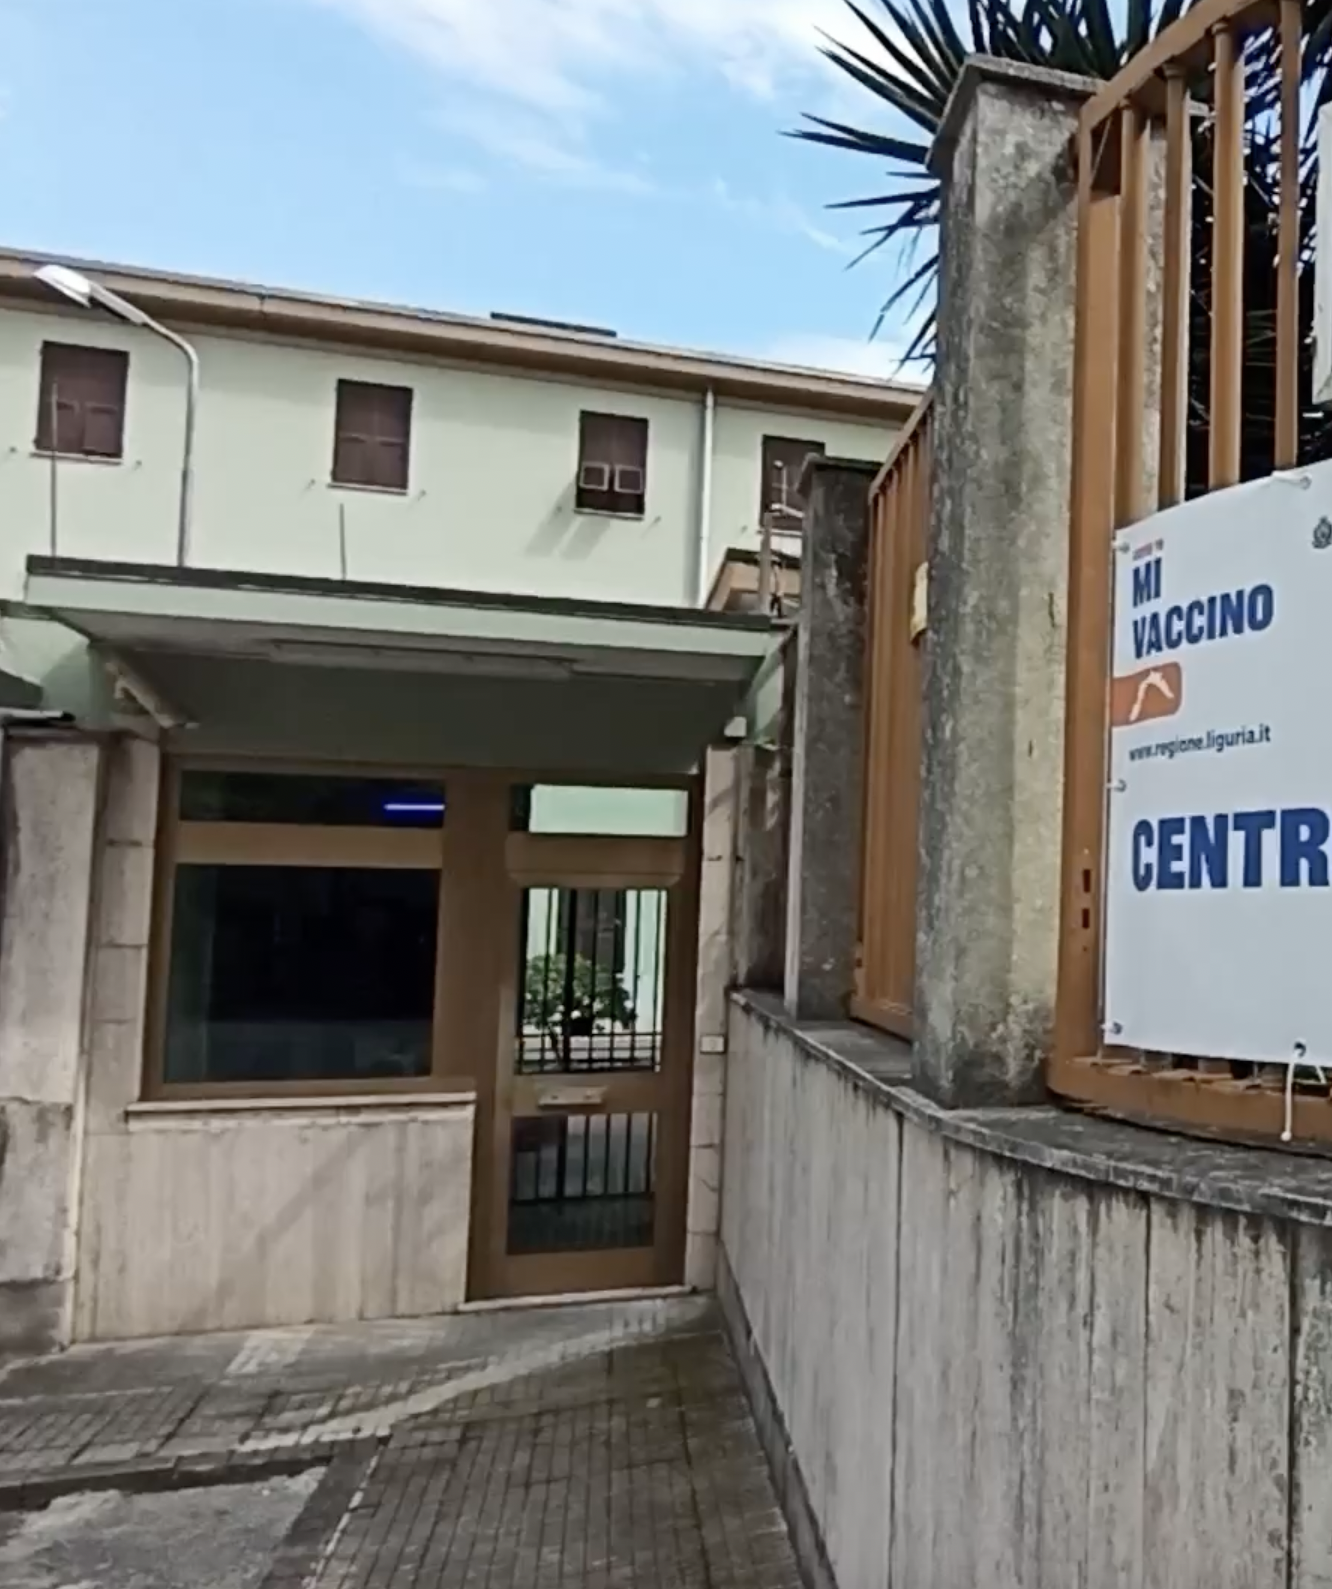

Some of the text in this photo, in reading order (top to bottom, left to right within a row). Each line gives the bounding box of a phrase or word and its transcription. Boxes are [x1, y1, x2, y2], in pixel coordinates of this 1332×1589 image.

[1132, 557, 1163, 607] MI
[1132, 583, 1274, 659] VACCINO
[1129, 724, 1271, 761] www.regione.liguria.it
